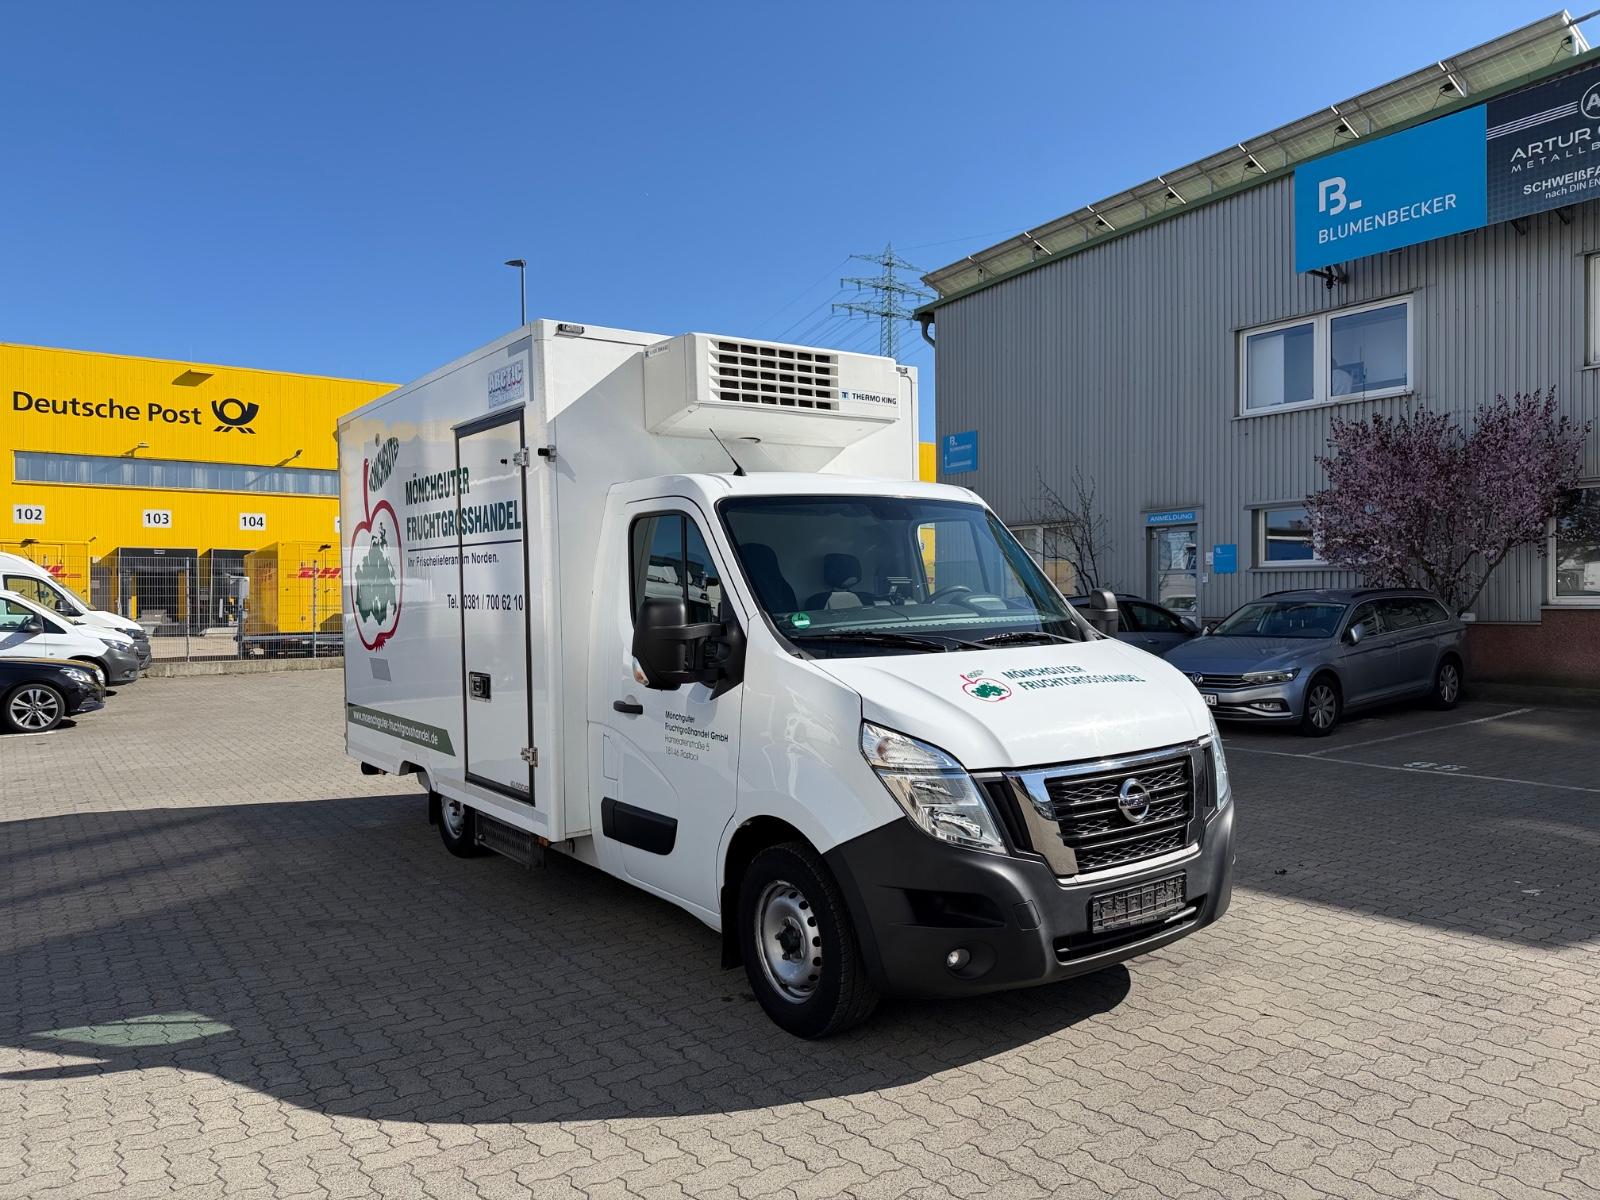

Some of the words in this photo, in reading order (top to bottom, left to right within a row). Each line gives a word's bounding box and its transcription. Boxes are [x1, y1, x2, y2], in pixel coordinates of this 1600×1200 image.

[1510, 127, 1592, 163] ARTUR
[1545, 185, 1568, 200] nach
[1569, 181, 1587, 193] DIN
[1318, 193, 1457, 245] BLUMENBECKER
[852, 392, 881, 403] THERMO
[882, 396, 897, 405] KING
[13, 390, 140, 421] Deutsche
[148, 402, 202, 425] Post
[405, 466, 470, 506] MÖNCHGUTER
[16, 508, 43, 521] 102
[145, 512, 170, 525] 103
[241, 516, 264, 527] 104
[1150, 512, 1193, 522] ANMELDUNG
[416, 556, 459, 567] Frischelieferan
[471, 551, 500, 564] Norden.
[298, 567, 341, 579] DH
[447, 593, 459, 609] Tel.
[463, 595, 480, 610] 0381
[486, 594, 500, 610] 700
[501, 594, 511, 611] 62
[513, 594, 524, 611] 10
[1001, 664, 1087, 680] MÖNCHGUTER
[1017, 674, 1147, 691] FRUCHTGROSSHANDEL
[665, 710, 696, 724] Mönchguter
[665, 722, 710, 739] Fruchtgroßhandel
[711, 731, 729, 743] GmbH
